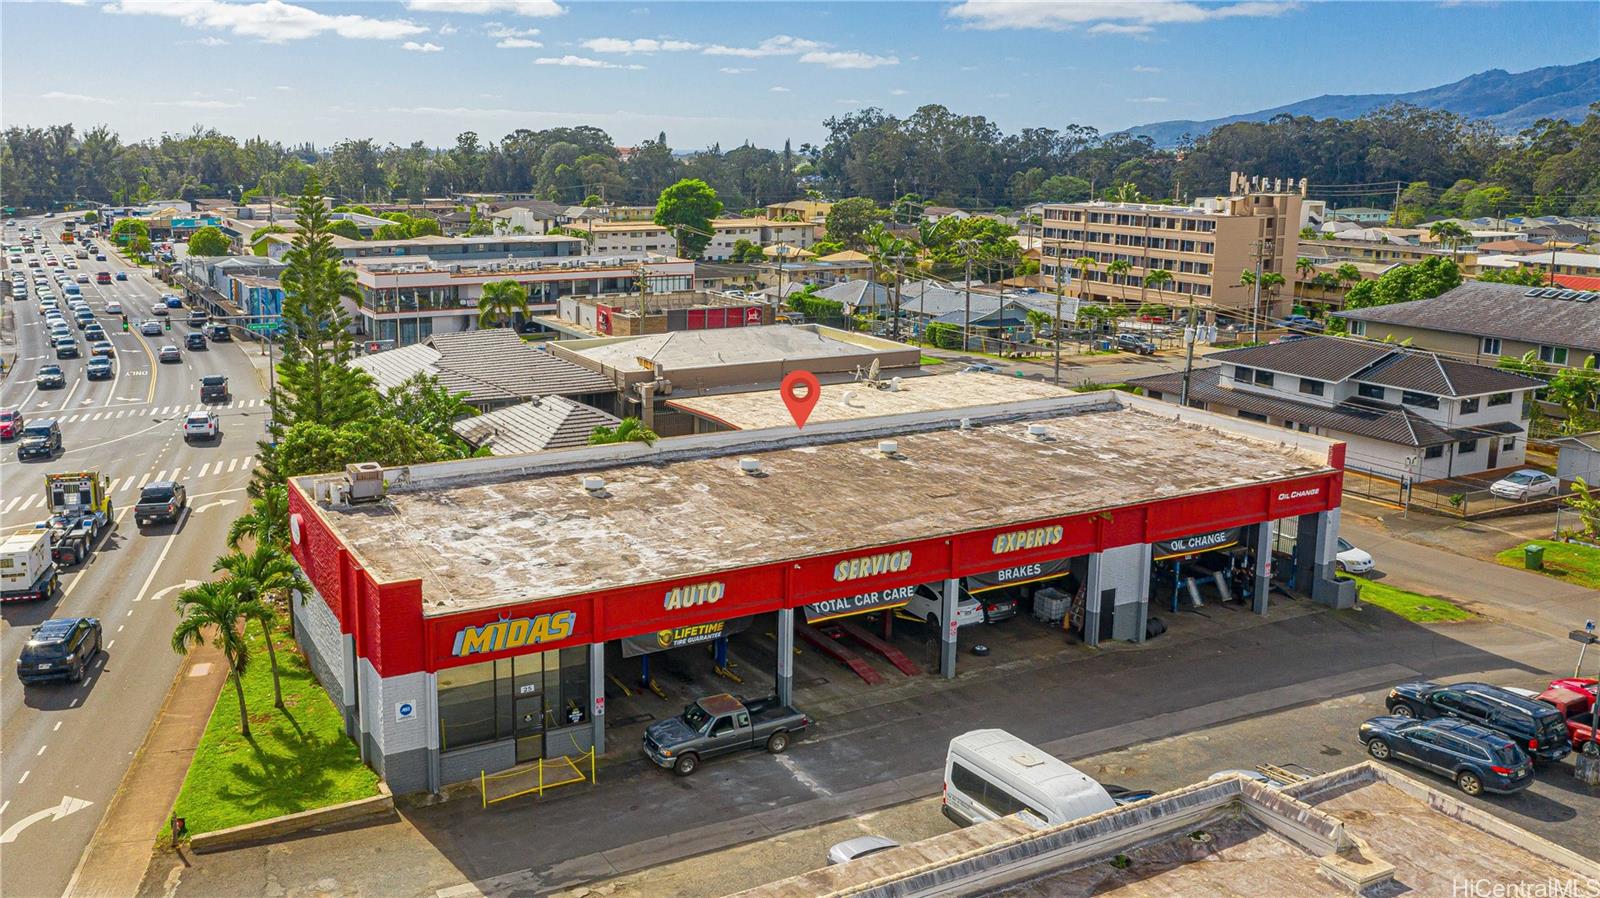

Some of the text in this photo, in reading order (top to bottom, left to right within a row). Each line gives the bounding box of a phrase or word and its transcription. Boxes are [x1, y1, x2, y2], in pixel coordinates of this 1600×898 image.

[1278, 487, 1320, 501] OIL CHANGE
[992, 525, 1063, 554] EXPERTS
[1170, 531, 1226, 552] OIL CHANGE
[833, 550, 912, 582] SERVICE
[998, 563, 1041, 581] BRAKES
[665, 581, 726, 611] AUTO
[812, 586, 914, 614] TOTAL CAR CARE
[453, 610, 575, 656] MIDAS
[673, 631, 722, 646] TIRE GUARANTEE
[674, 621, 725, 640] LIFETIME
